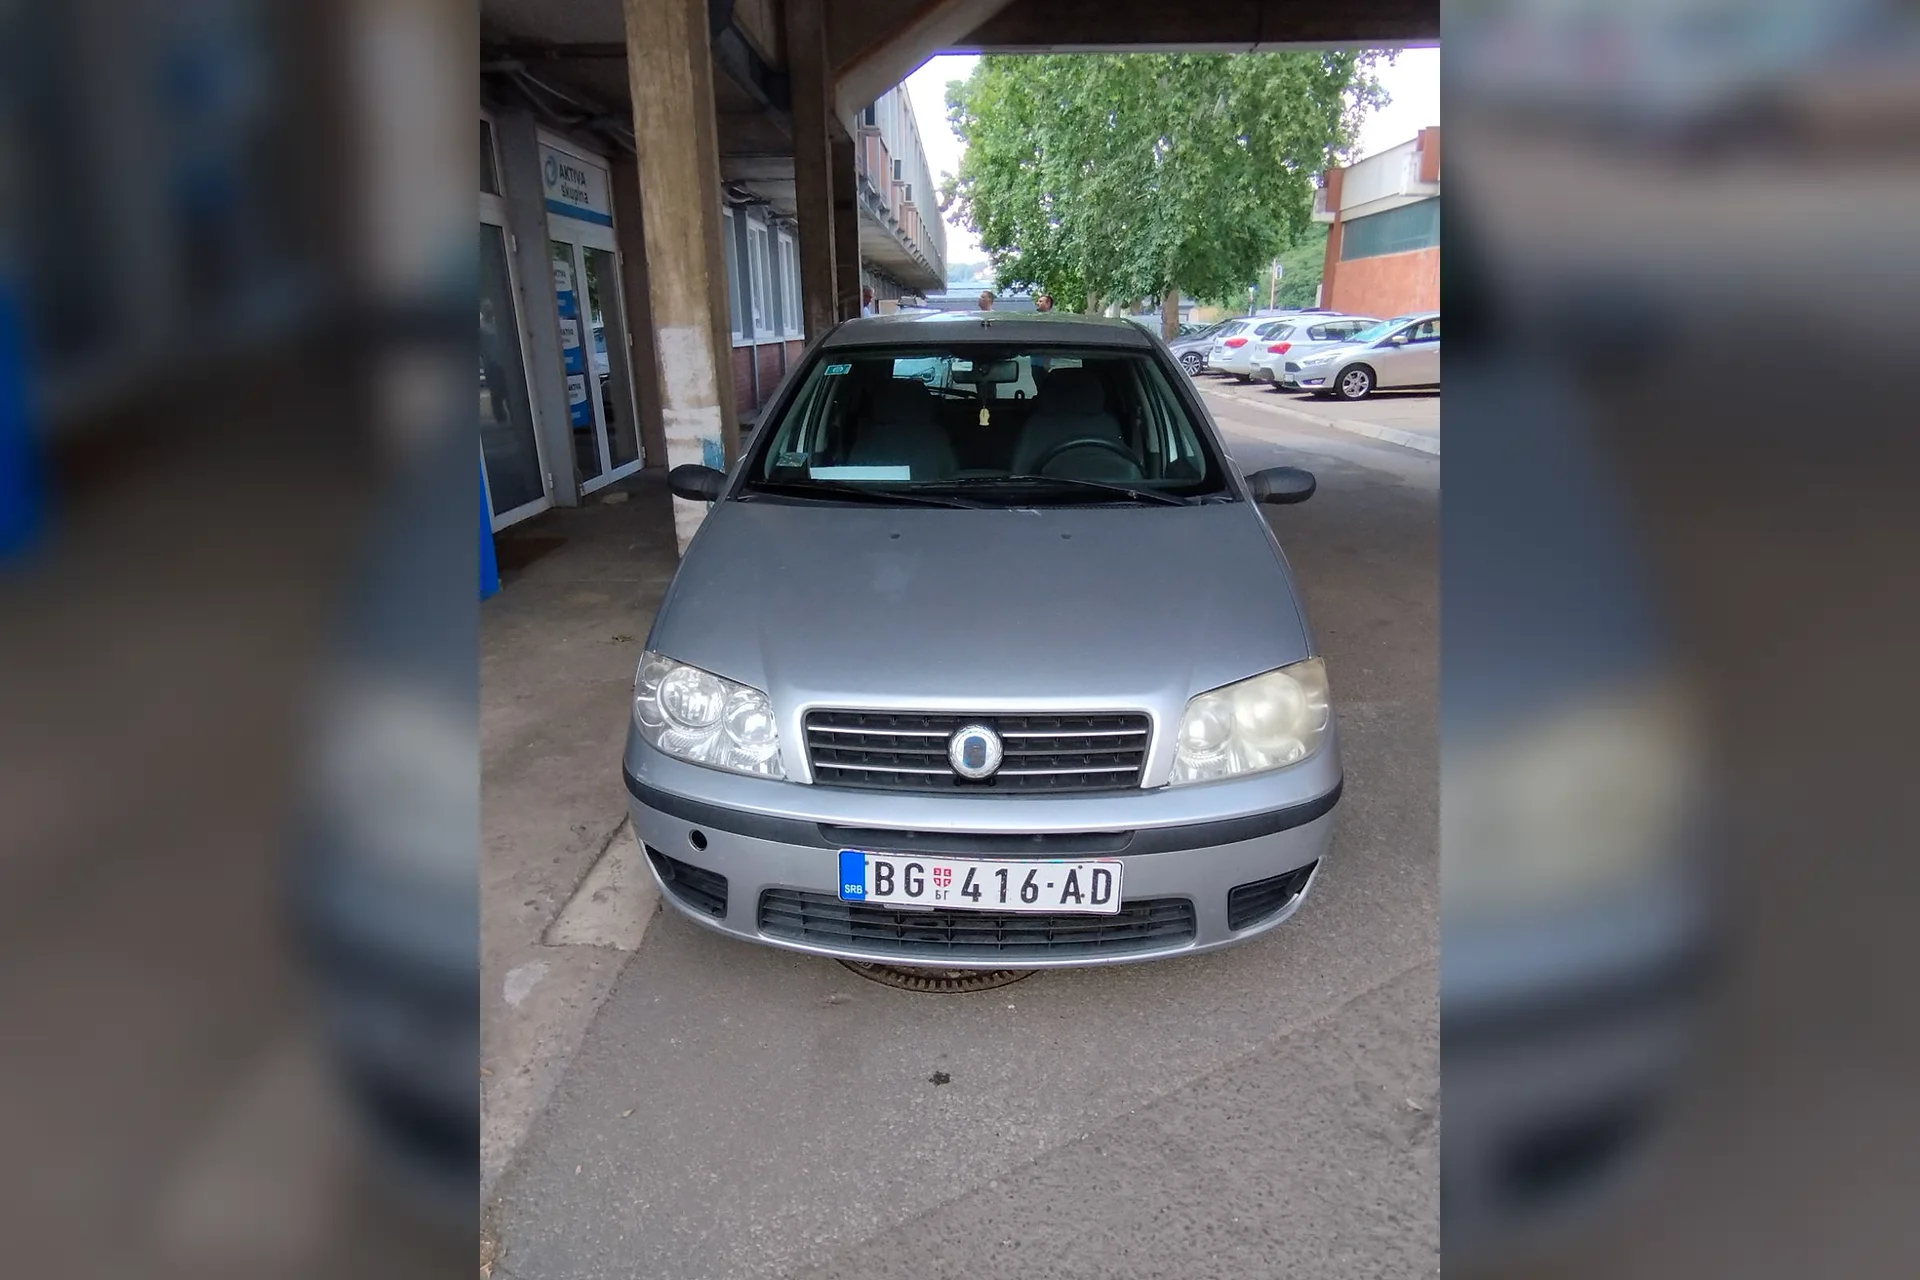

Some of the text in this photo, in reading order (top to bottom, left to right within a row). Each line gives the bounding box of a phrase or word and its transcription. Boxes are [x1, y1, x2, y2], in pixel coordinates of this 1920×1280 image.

[560, 164, 586, 187] AKTIVA
[844, 884, 863, 894] SRB
[874, 861, 925, 898] BG
